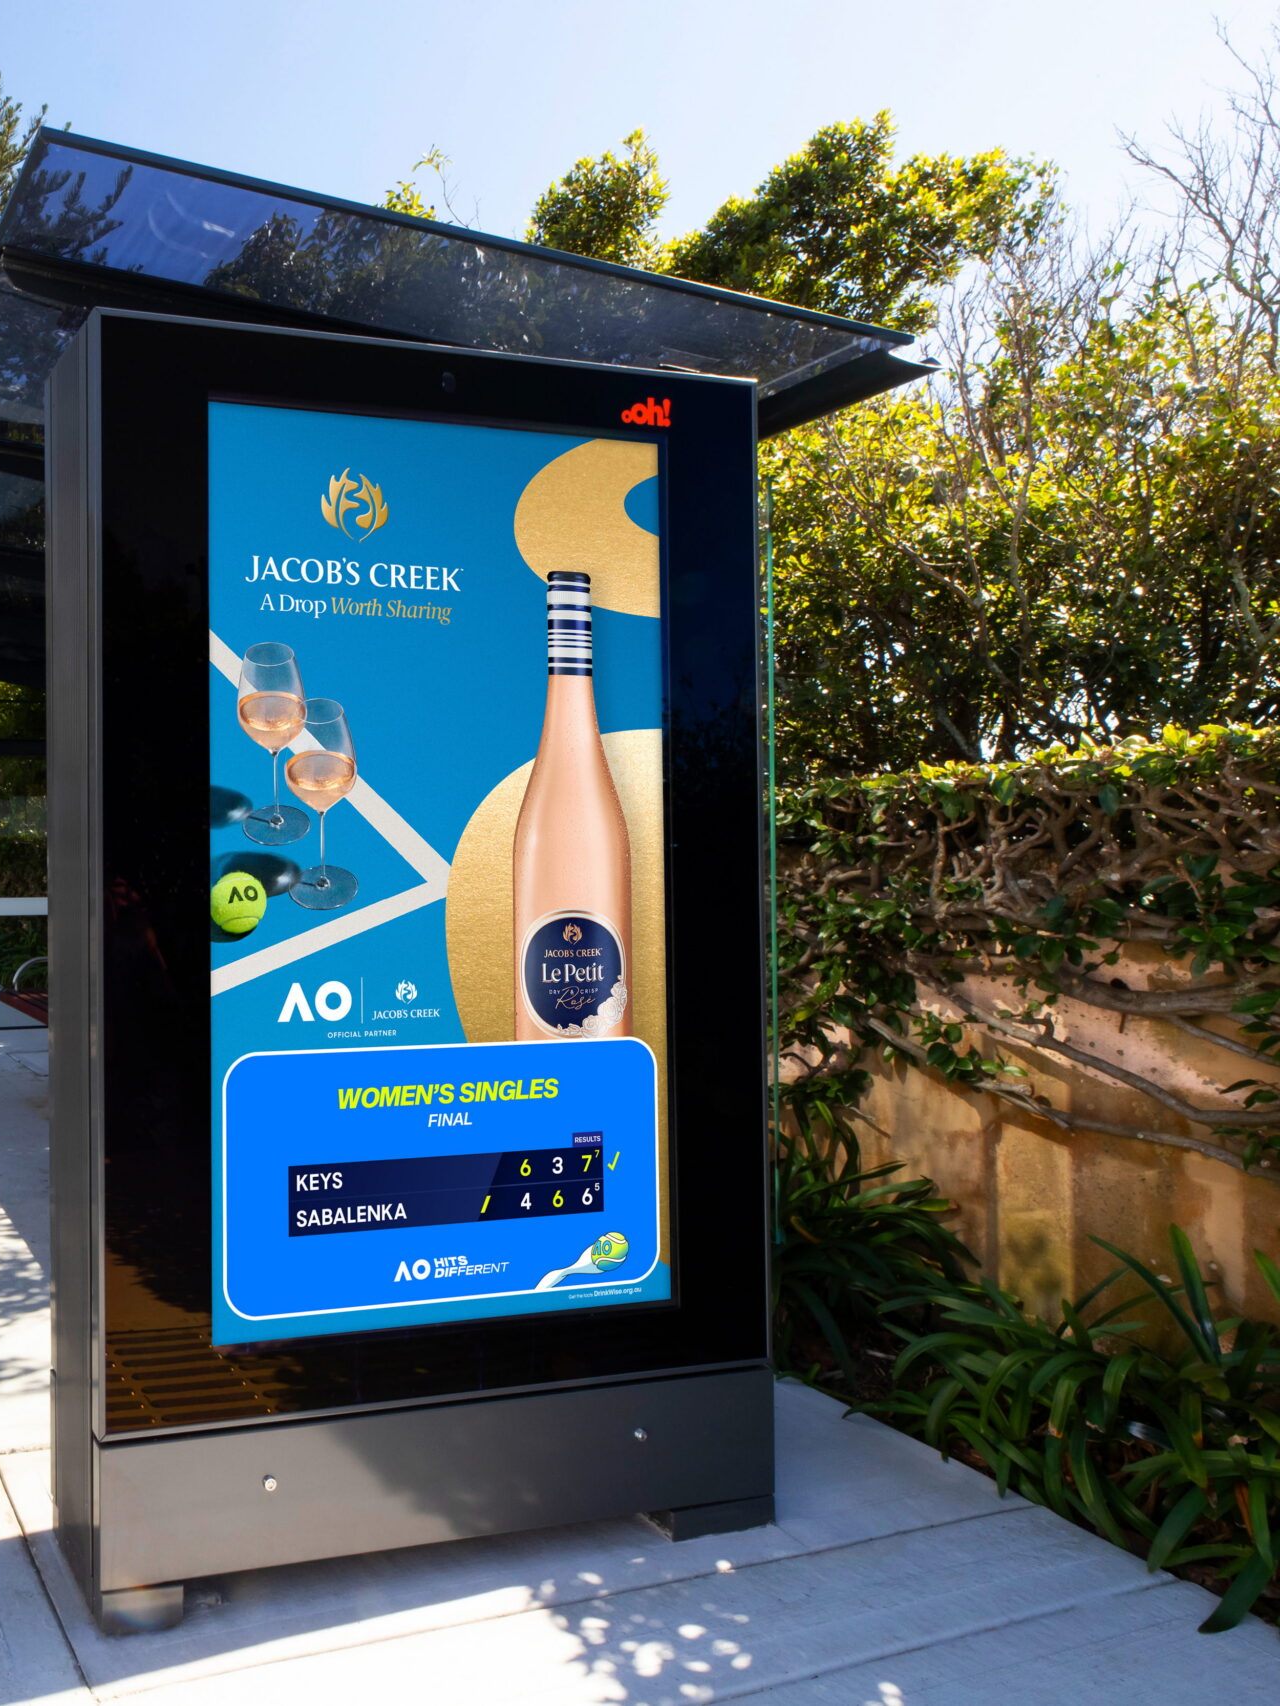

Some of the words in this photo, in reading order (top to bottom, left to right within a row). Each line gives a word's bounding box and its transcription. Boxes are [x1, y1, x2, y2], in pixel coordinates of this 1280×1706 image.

[245, 555, 361, 586] JACOB'S
[369, 562, 461, 592] CREEK
[259, 593, 275, 611] A
[279, 594, 327, 619] Drop
[331, 596, 383, 617] Worth
[386, 599, 453, 626] Sharing
[542, 963, 561, 983] Le
[565, 962, 604, 983] Petit
[277, 980, 352, 1023] AO
[372, 1009, 408, 1021] JACOB'S
[410, 1008, 440, 1019] CREEK
[327, 1031, 361, 1039] OFFICIAL
[364, 1029, 397, 1038] PARTNER
[337, 1083, 454, 1110] WOMEN’S
[459, 1078, 559, 1104] SINGLES
[427, 1112, 473, 1128] FINAL
[296, 1172, 343, 1192] KEYS
[520, 1159, 532, 1176] 6
[552, 1157, 563, 1174] 3
[296, 1202, 407, 1228] SABALENKA
[520, 1192, 532, 1210] 4
[552, 1190, 564, 1208] 6
[434, 1256, 468, 1268] HITS
[434, 1261, 510, 1279] DIFFERENT
